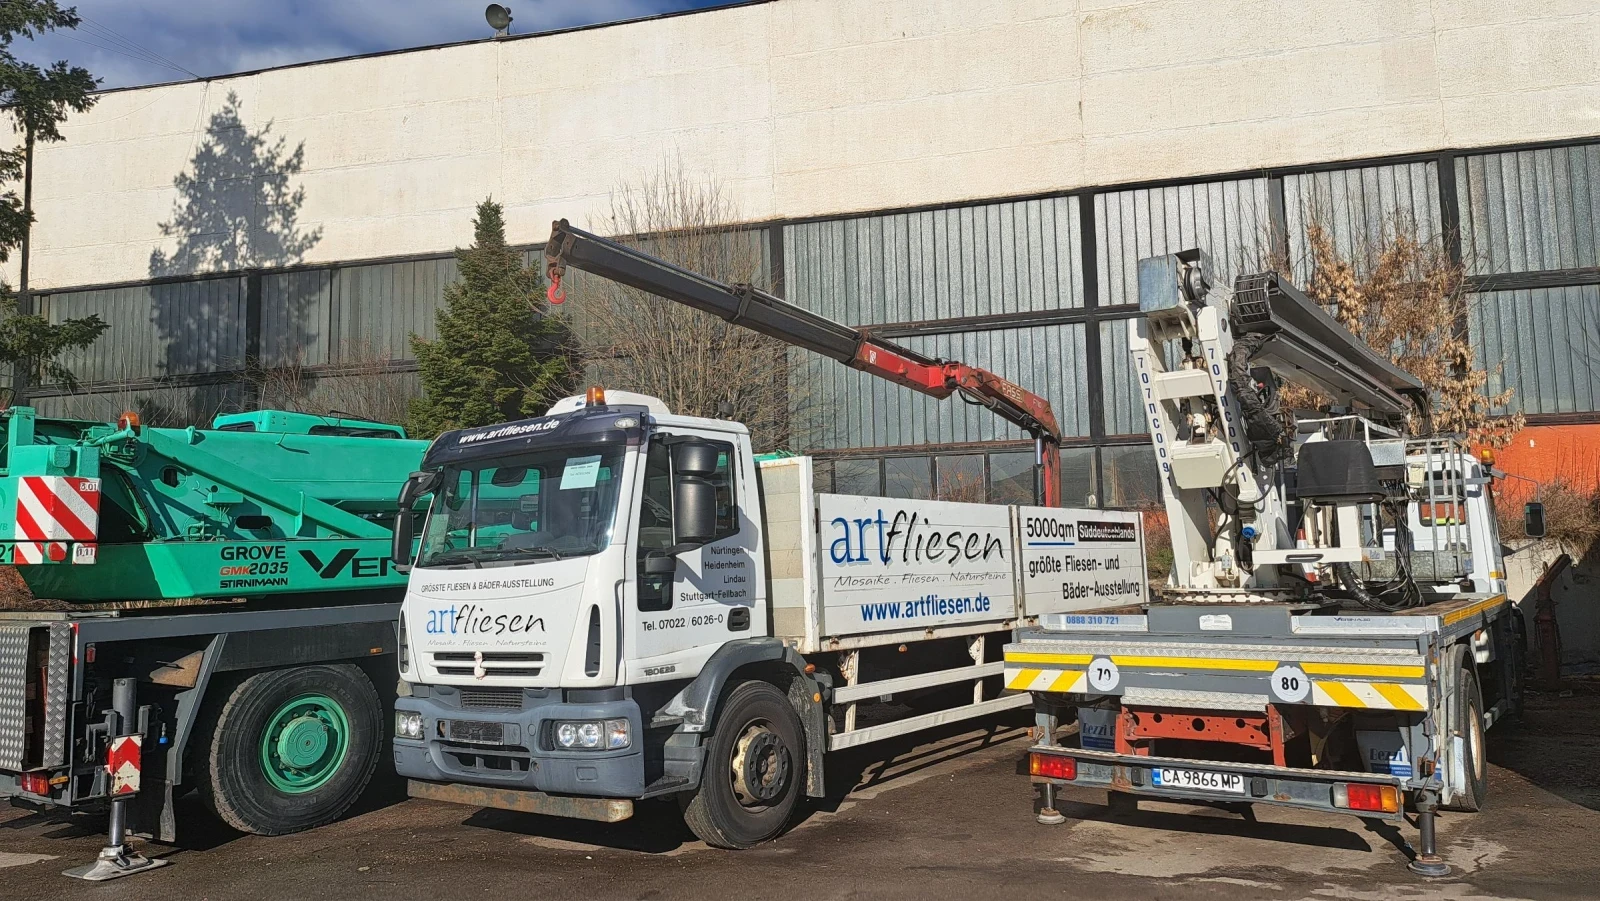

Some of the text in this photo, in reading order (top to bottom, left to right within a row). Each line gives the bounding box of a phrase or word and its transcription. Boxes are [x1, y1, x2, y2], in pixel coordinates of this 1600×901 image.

[459, 420, 560, 444] www.artfliesen.de
[1026, 517, 1075, 541] 5000qm
[830, 508, 1005, 566] artfliesen
[221, 545, 286, 560] GROVE
[710, 546, 745, 556] Nürtingen
[219, 561, 289, 576] GMK2035
[704, 560, 746, 570] Heidenheim
[1028, 555, 1062, 578] größte
[1104, 554, 1120, 570] und
[219, 577, 288, 589] STIRNIMANN
[421, 577, 554, 593] GRÖSSTE FLIESEN & BÄDER-AUSSTELLUNG
[723, 575, 746, 583] Lindau
[834, 571, 1007, 587] Mosaike Fliesen Natursteine
[680, 589, 747, 602] Stuttgart-Fellbach
[1062, 579, 1140, 600] Bäder-Ausstellung
[861, 592, 990, 621] www.artfliesen.de
[426, 603, 546, 635] artfliesen
[642, 621, 657, 631] Tel.
[659, 618, 686, 630] 07022
[1066, 616, 1119, 625] 0888 310 721
[1281, 676, 1299, 691] 80
[1162, 768, 1241, 789] CA 9866 MP
